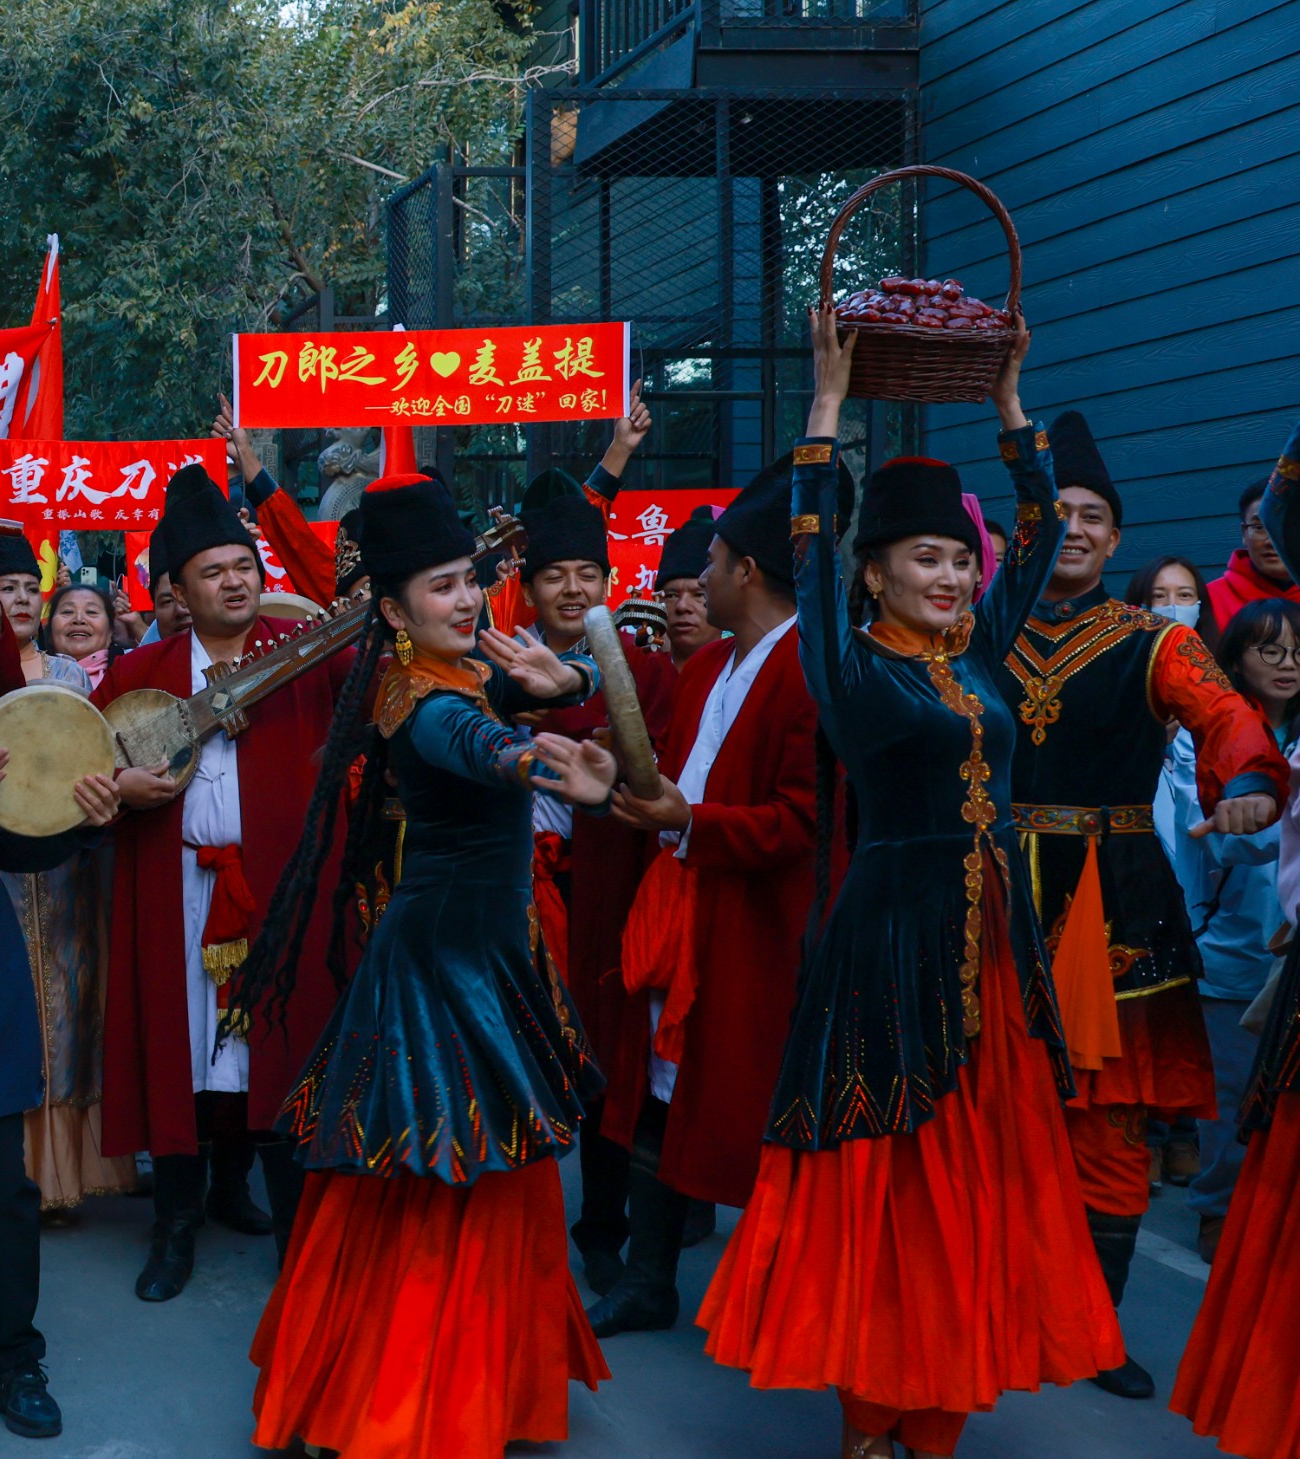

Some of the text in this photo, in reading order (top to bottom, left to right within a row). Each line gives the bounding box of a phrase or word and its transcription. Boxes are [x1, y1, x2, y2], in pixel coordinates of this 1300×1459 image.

[252, 336, 605, 394] 刀郎之乡 麦盖提
[1, 453, 204, 505] 重庆刀
[41, 508, 105, 521] 重振山歌
